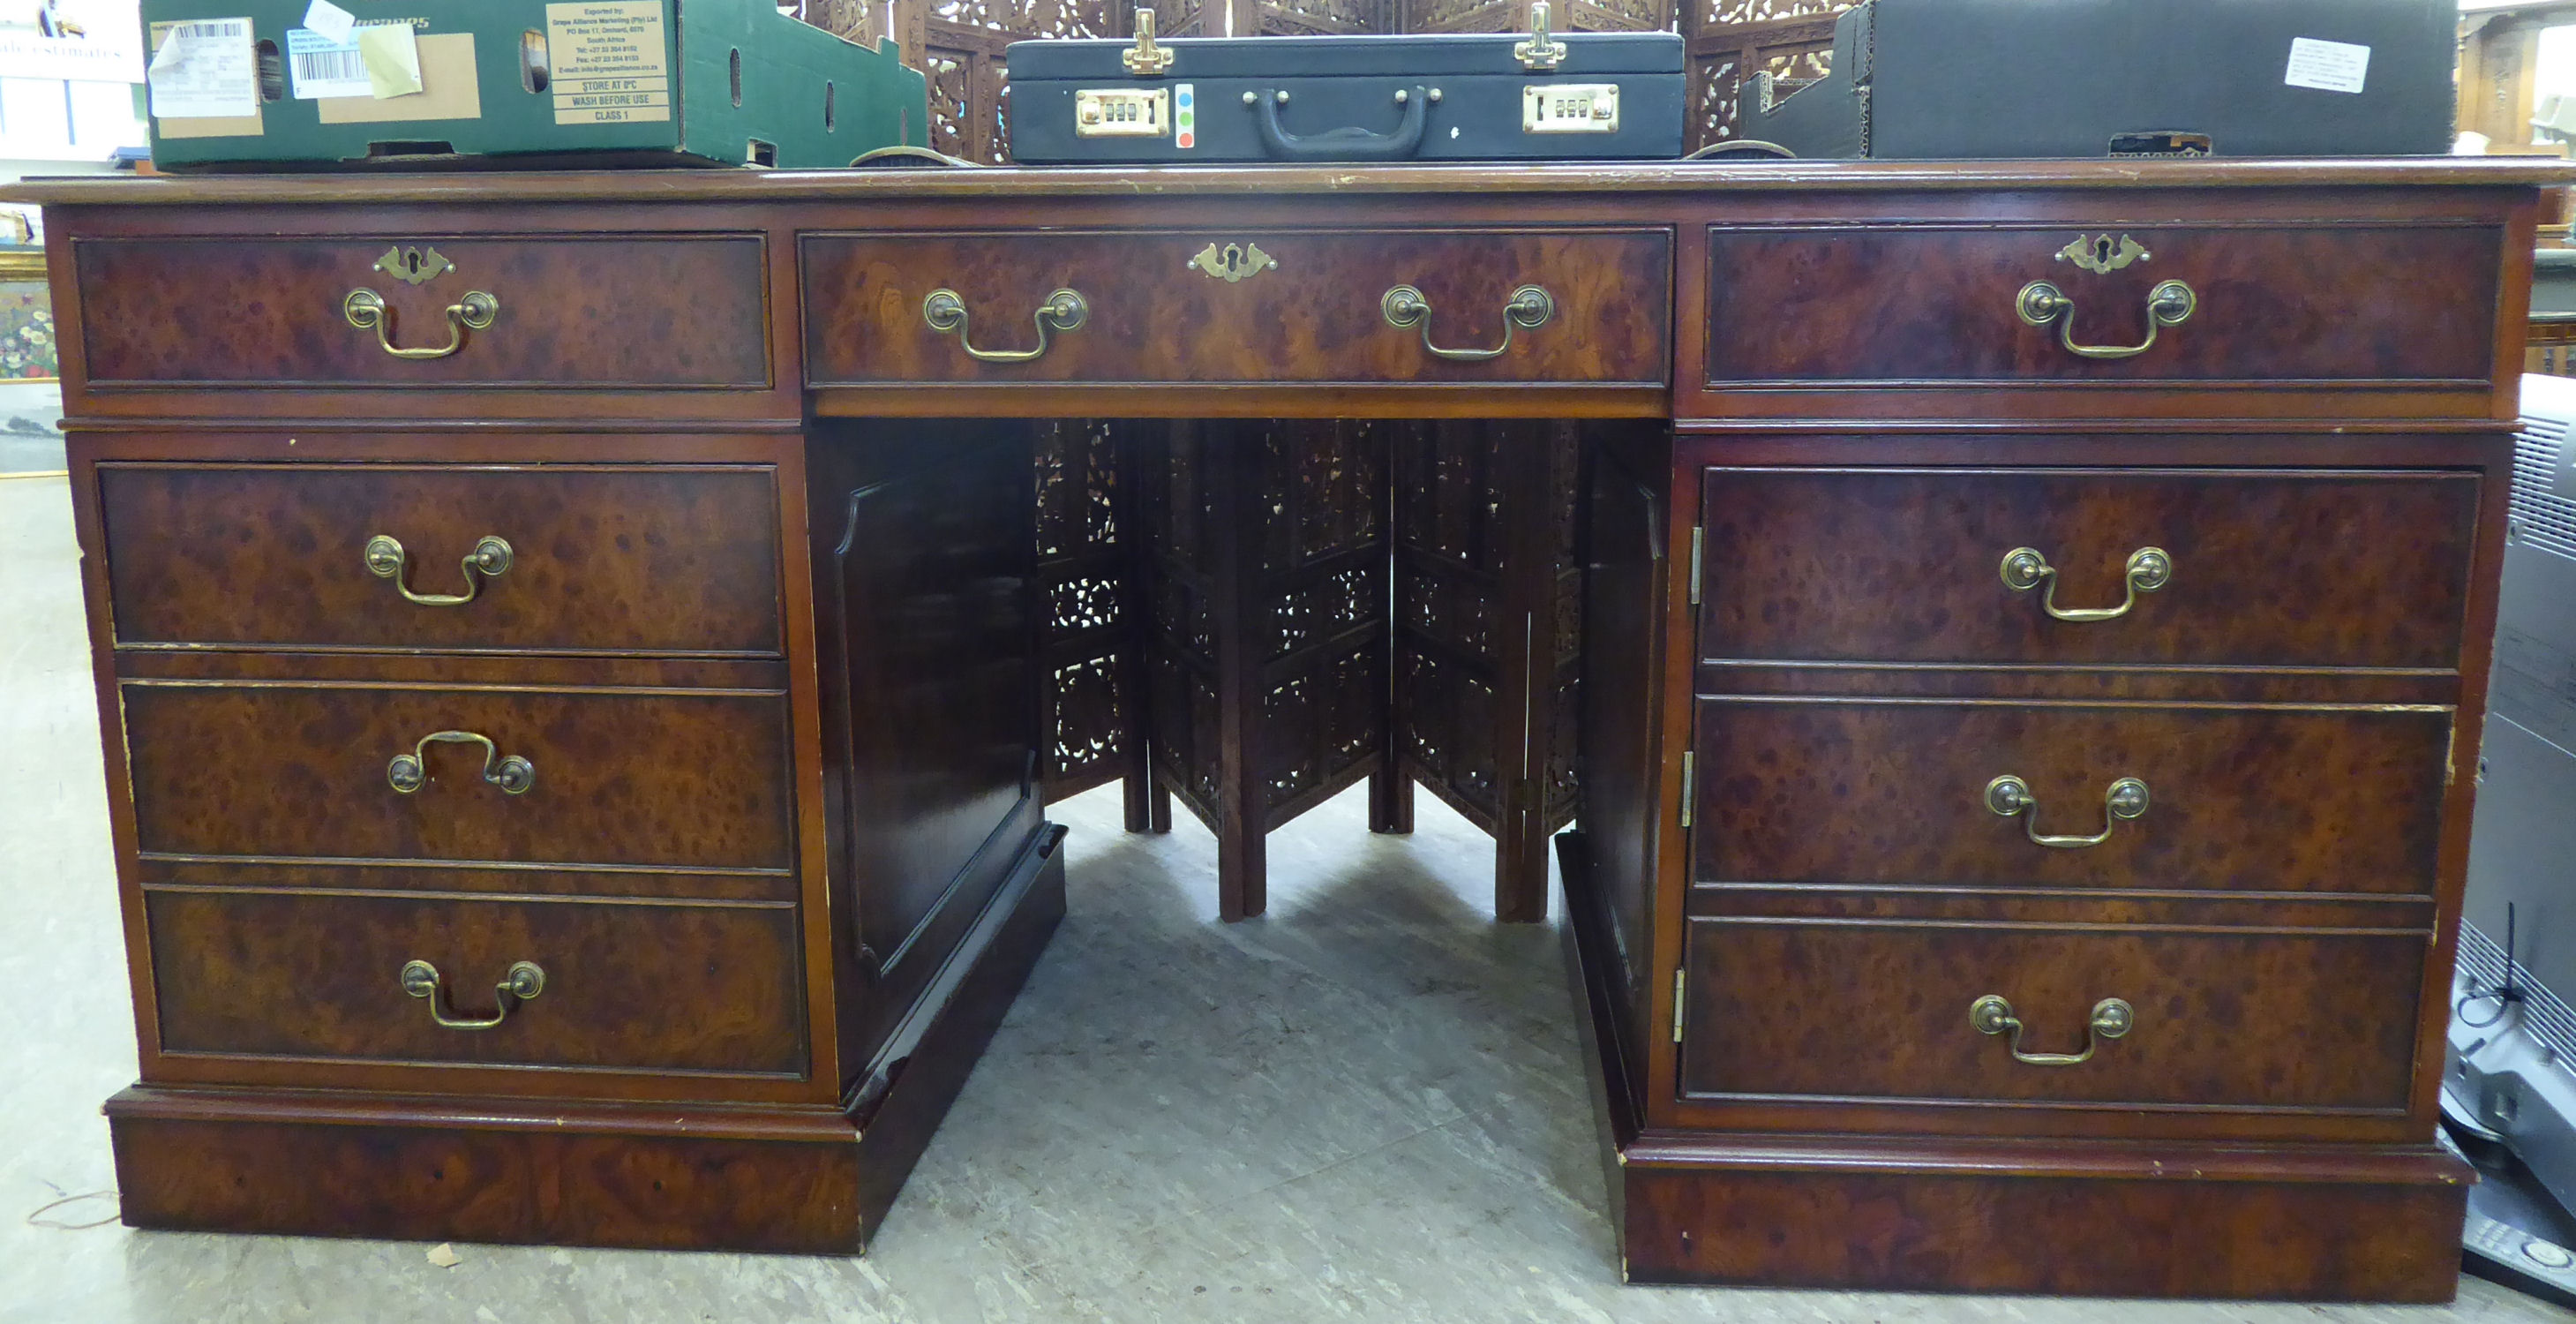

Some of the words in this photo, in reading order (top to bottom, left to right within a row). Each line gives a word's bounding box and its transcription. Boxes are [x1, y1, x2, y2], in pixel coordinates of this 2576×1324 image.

[582, 82, 609, 92] STORE
[612, 81, 620, 90] AT
[572, 96, 597, 106] WASH
[598, 95, 630, 104] BEFORE
[634, 94, 650, 103] USE
[595, 110, 621, 120] CLASS
